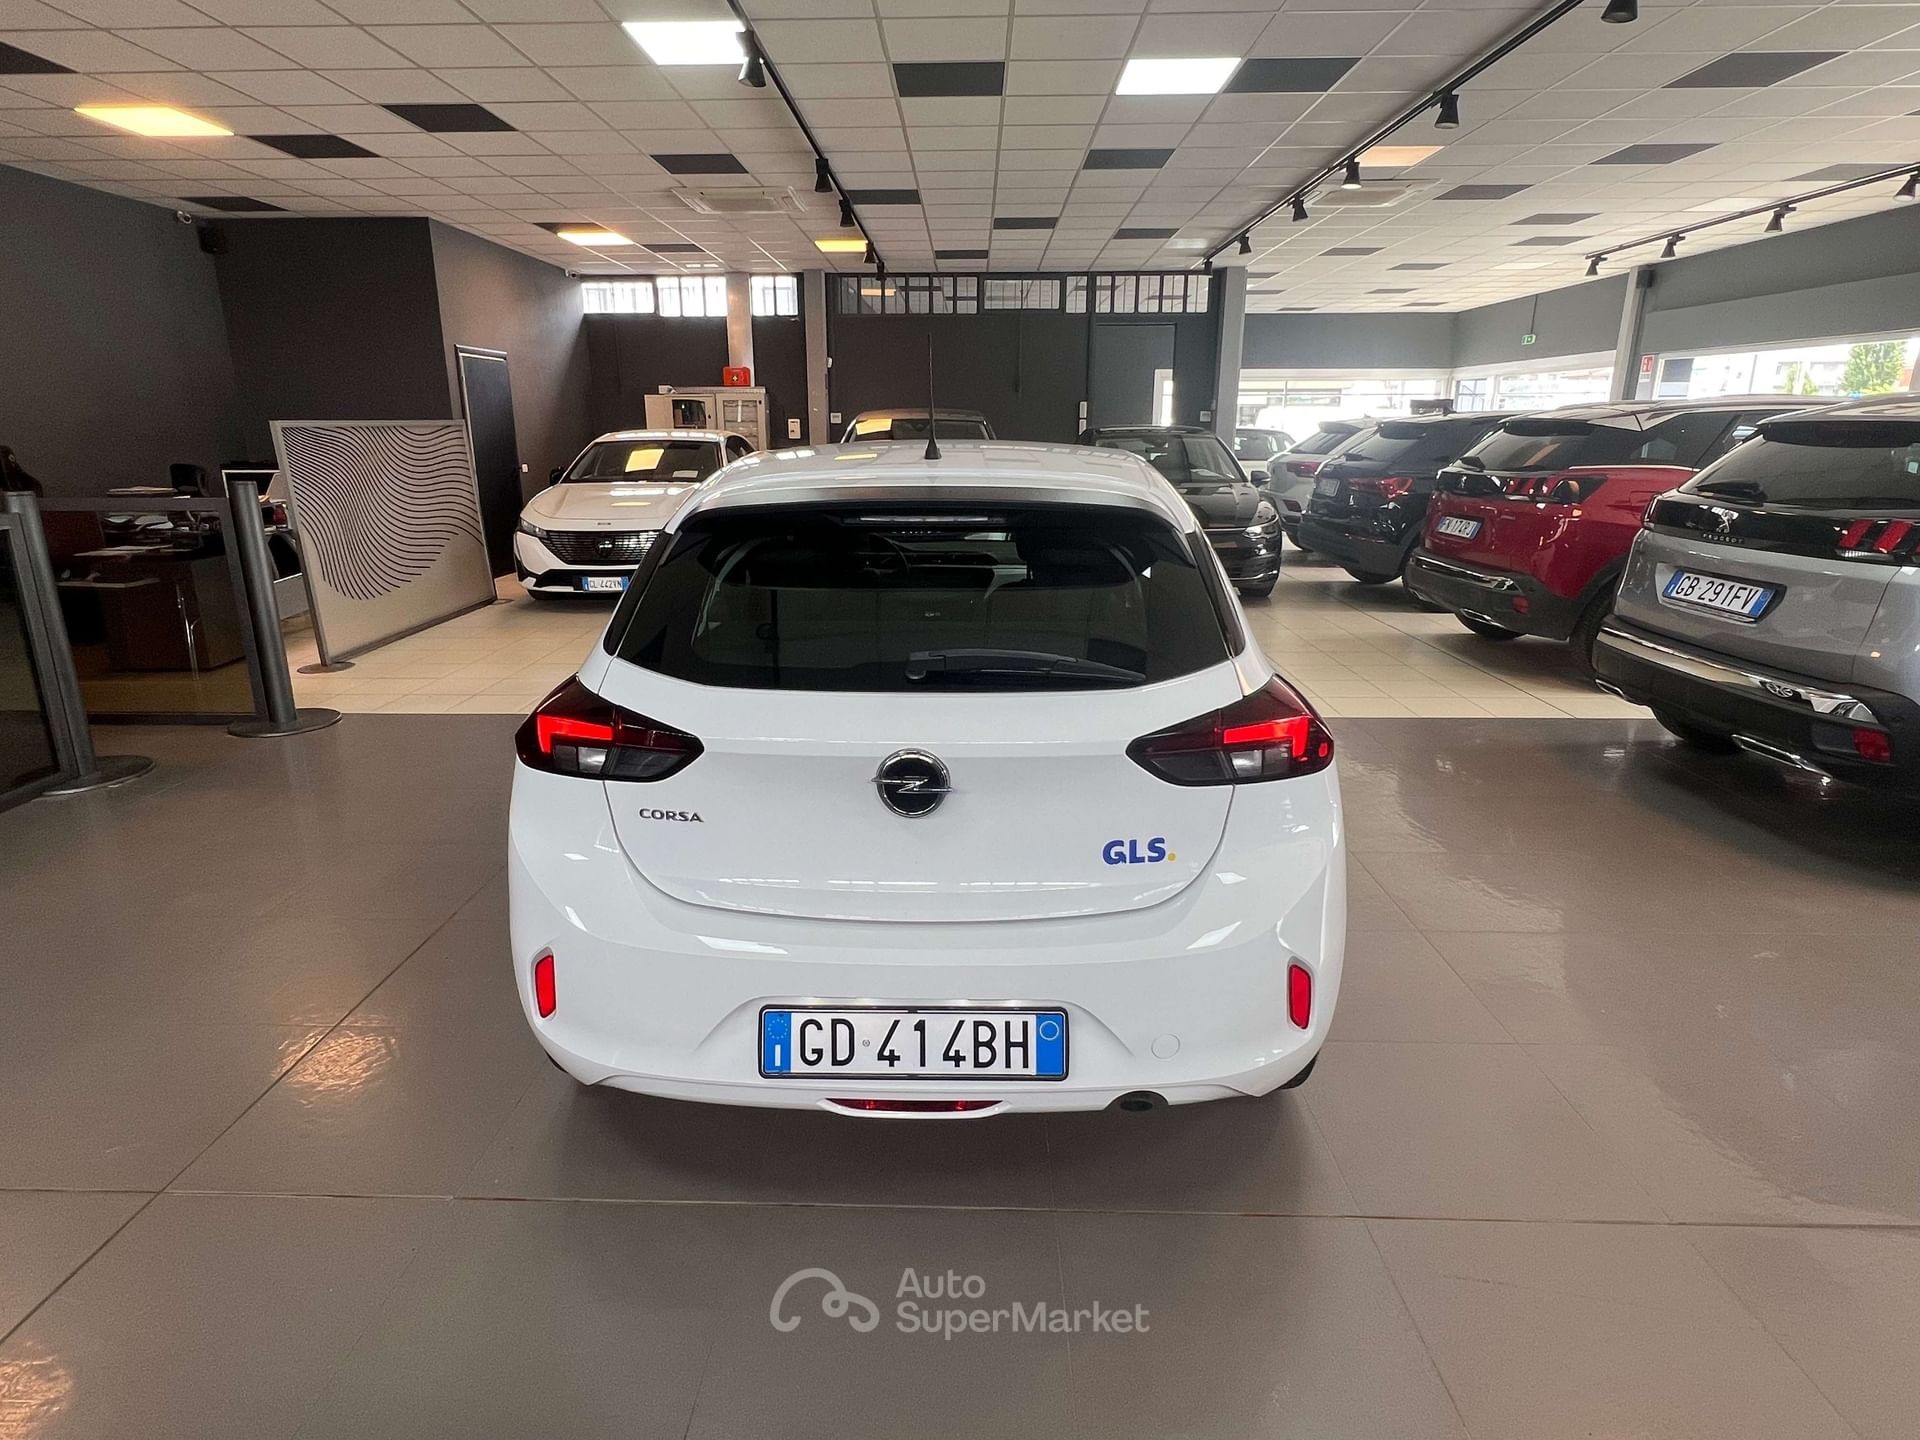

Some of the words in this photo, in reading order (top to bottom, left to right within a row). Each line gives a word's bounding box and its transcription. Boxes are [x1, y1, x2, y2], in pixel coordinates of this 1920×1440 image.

[1675, 575, 1700, 597] GB
[1698, 580, 1759, 610] 291FV
[639, 808, 704, 823] CORSA
[799, 1018, 855, 1067] GD
[876, 1019, 1030, 1069] 414BH
